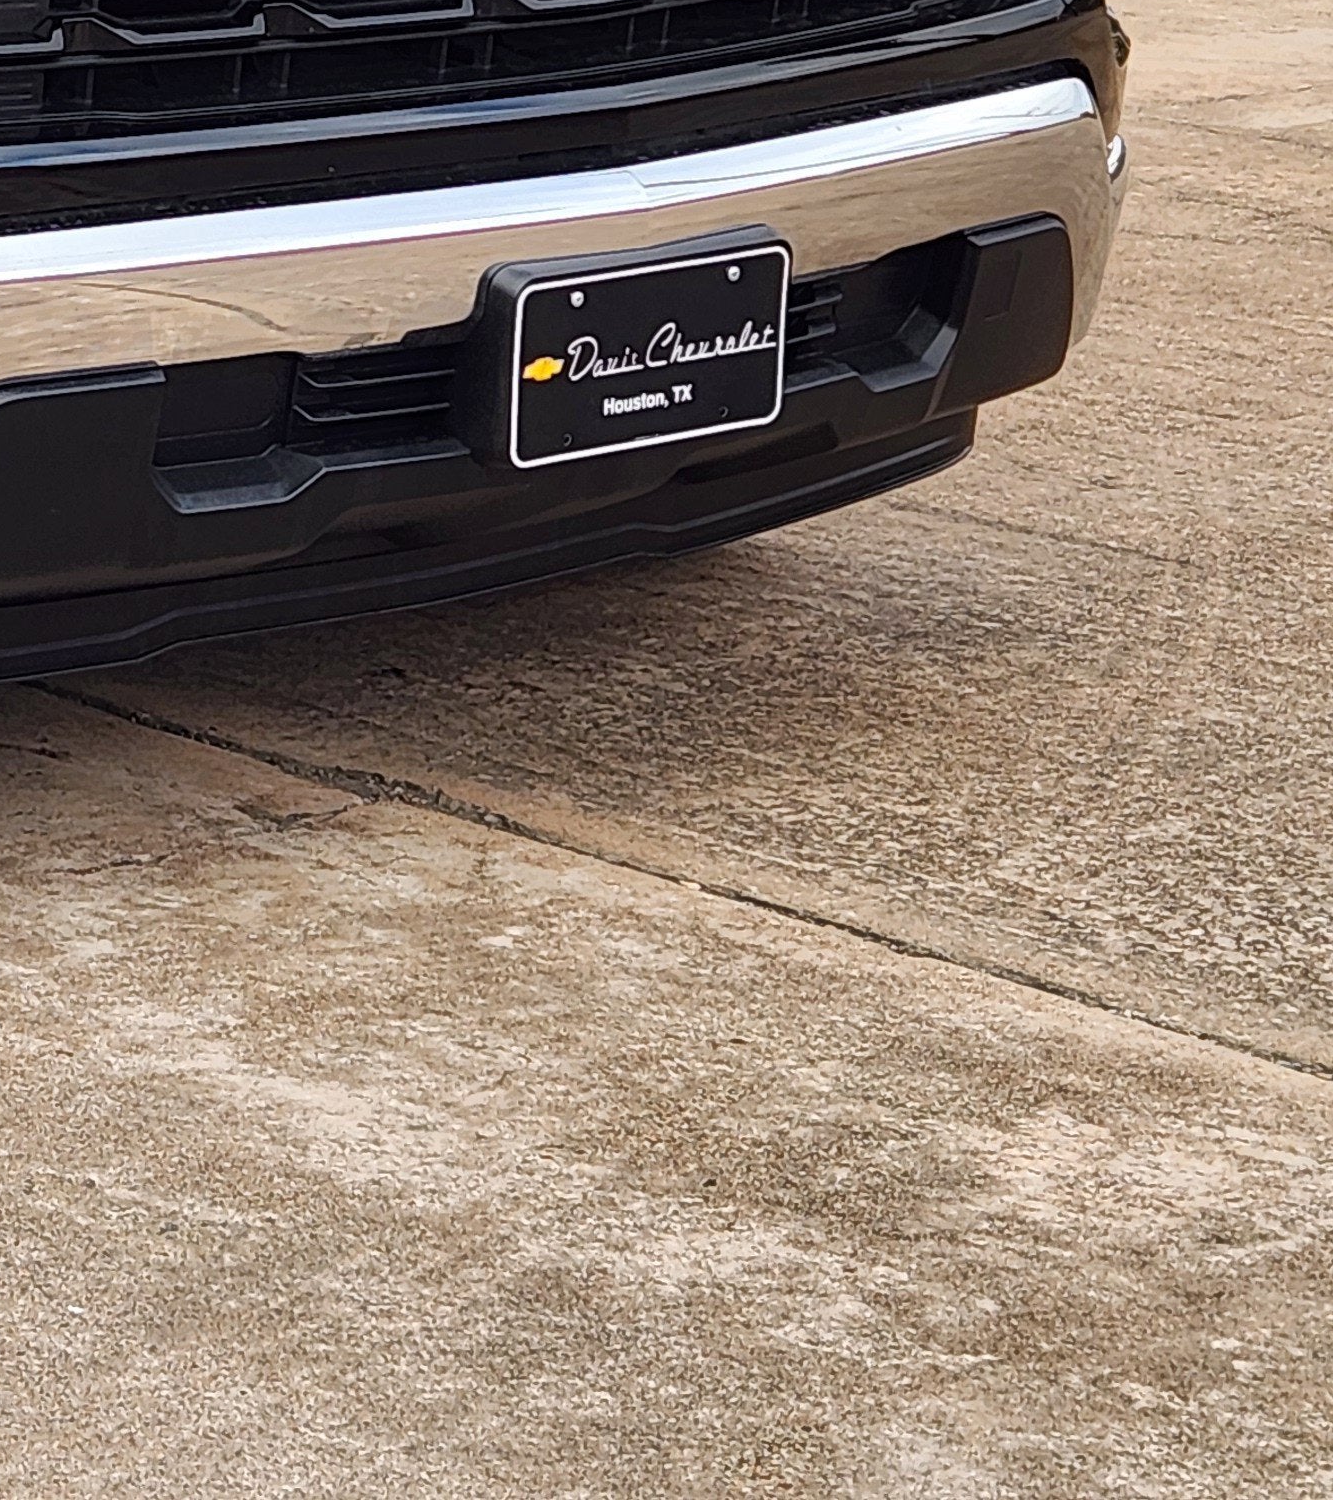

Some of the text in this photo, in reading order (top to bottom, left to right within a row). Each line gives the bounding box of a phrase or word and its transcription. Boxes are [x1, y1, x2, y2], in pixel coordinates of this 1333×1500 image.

[567, 321, 777, 382] Davis Chevrolet
[603, 384, 693, 417] Houston, TX
